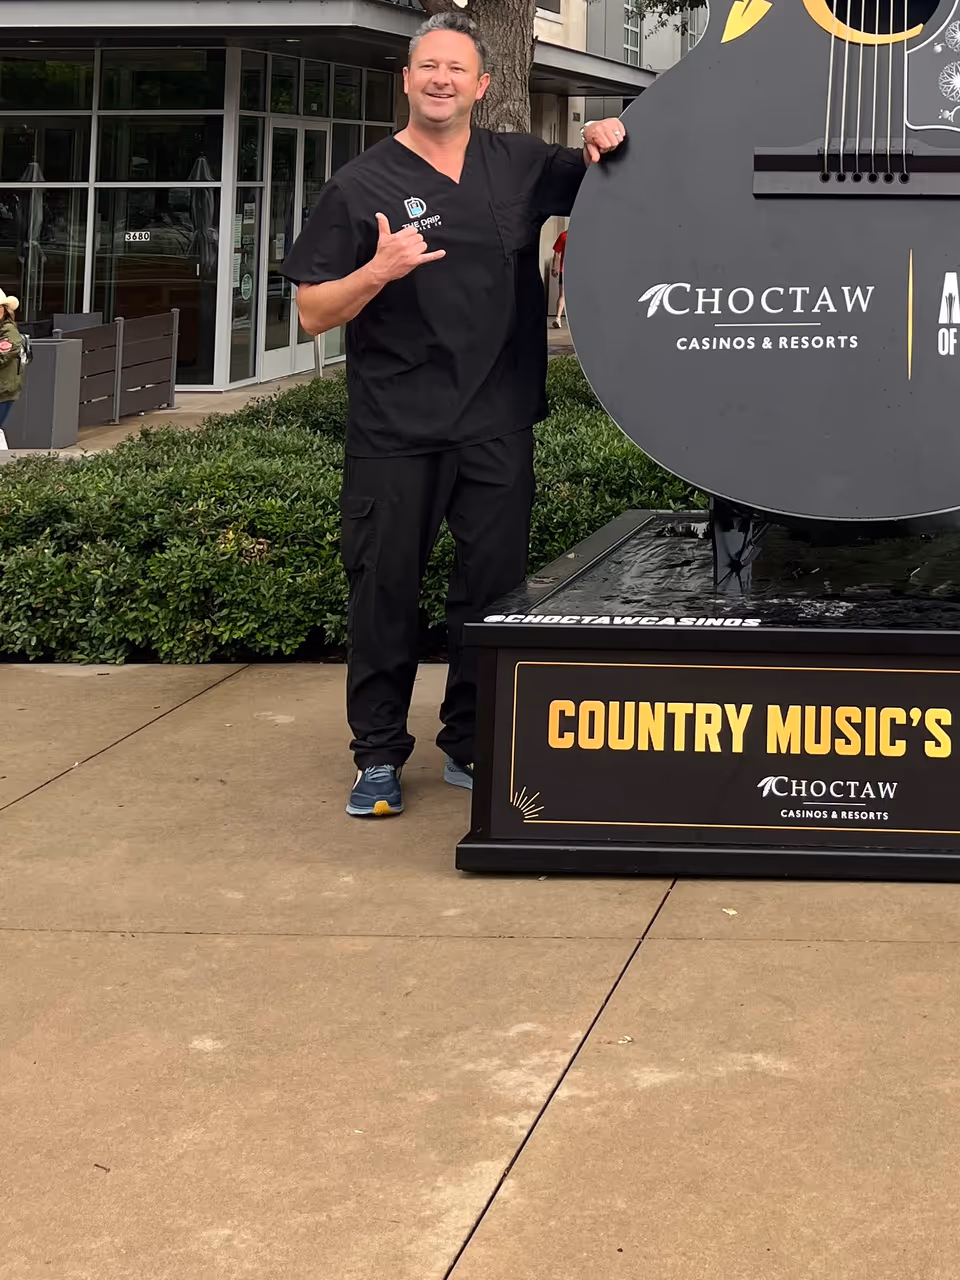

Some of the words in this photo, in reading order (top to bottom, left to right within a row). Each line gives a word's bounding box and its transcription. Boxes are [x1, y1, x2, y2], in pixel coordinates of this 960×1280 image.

[420, 214, 441, 226] DRIP
[125, 232, 150, 240] 3680
[660, 283, 875, 315] CHOCTAW
[676, 335, 755, 350] CASINOS
[762, 336, 773, 350] &
[778, 334, 858, 350] RESORTS
[938, 327, 957, 356] OF
[483, 614, 762, 627] @CHOCTAWCASINOS
[548, 698, 754, 753] COUNTRY
[766, 703, 952, 759] MUSIC'S
[770, 776, 898, 799] CHOCTAW
[780, 809, 828, 819] CASINOS
[831, 810, 838, 819] &
[841, 811, 889, 821] RESORTS
